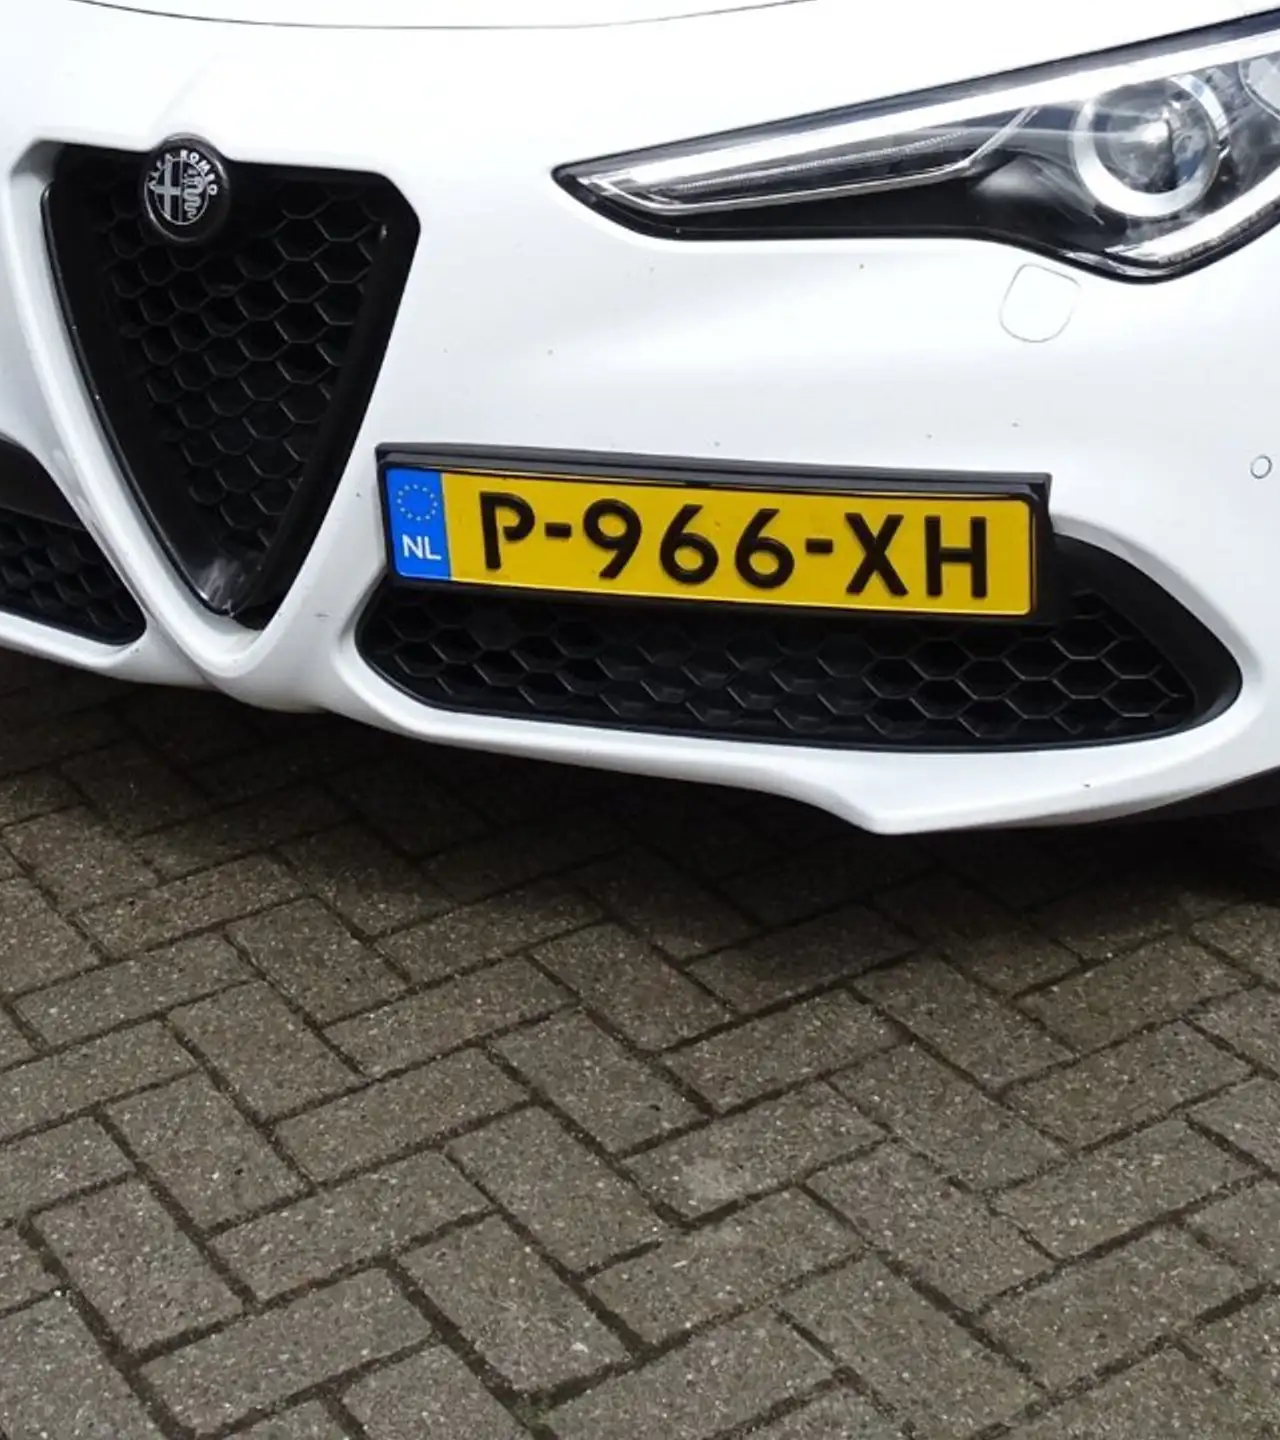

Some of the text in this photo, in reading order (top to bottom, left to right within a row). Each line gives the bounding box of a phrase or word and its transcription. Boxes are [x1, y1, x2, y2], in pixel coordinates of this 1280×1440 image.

[180, 149, 218, 195] ROMEO
[402, 533, 442, 562] NL
[478, 490, 990, 599] P-966-XH
